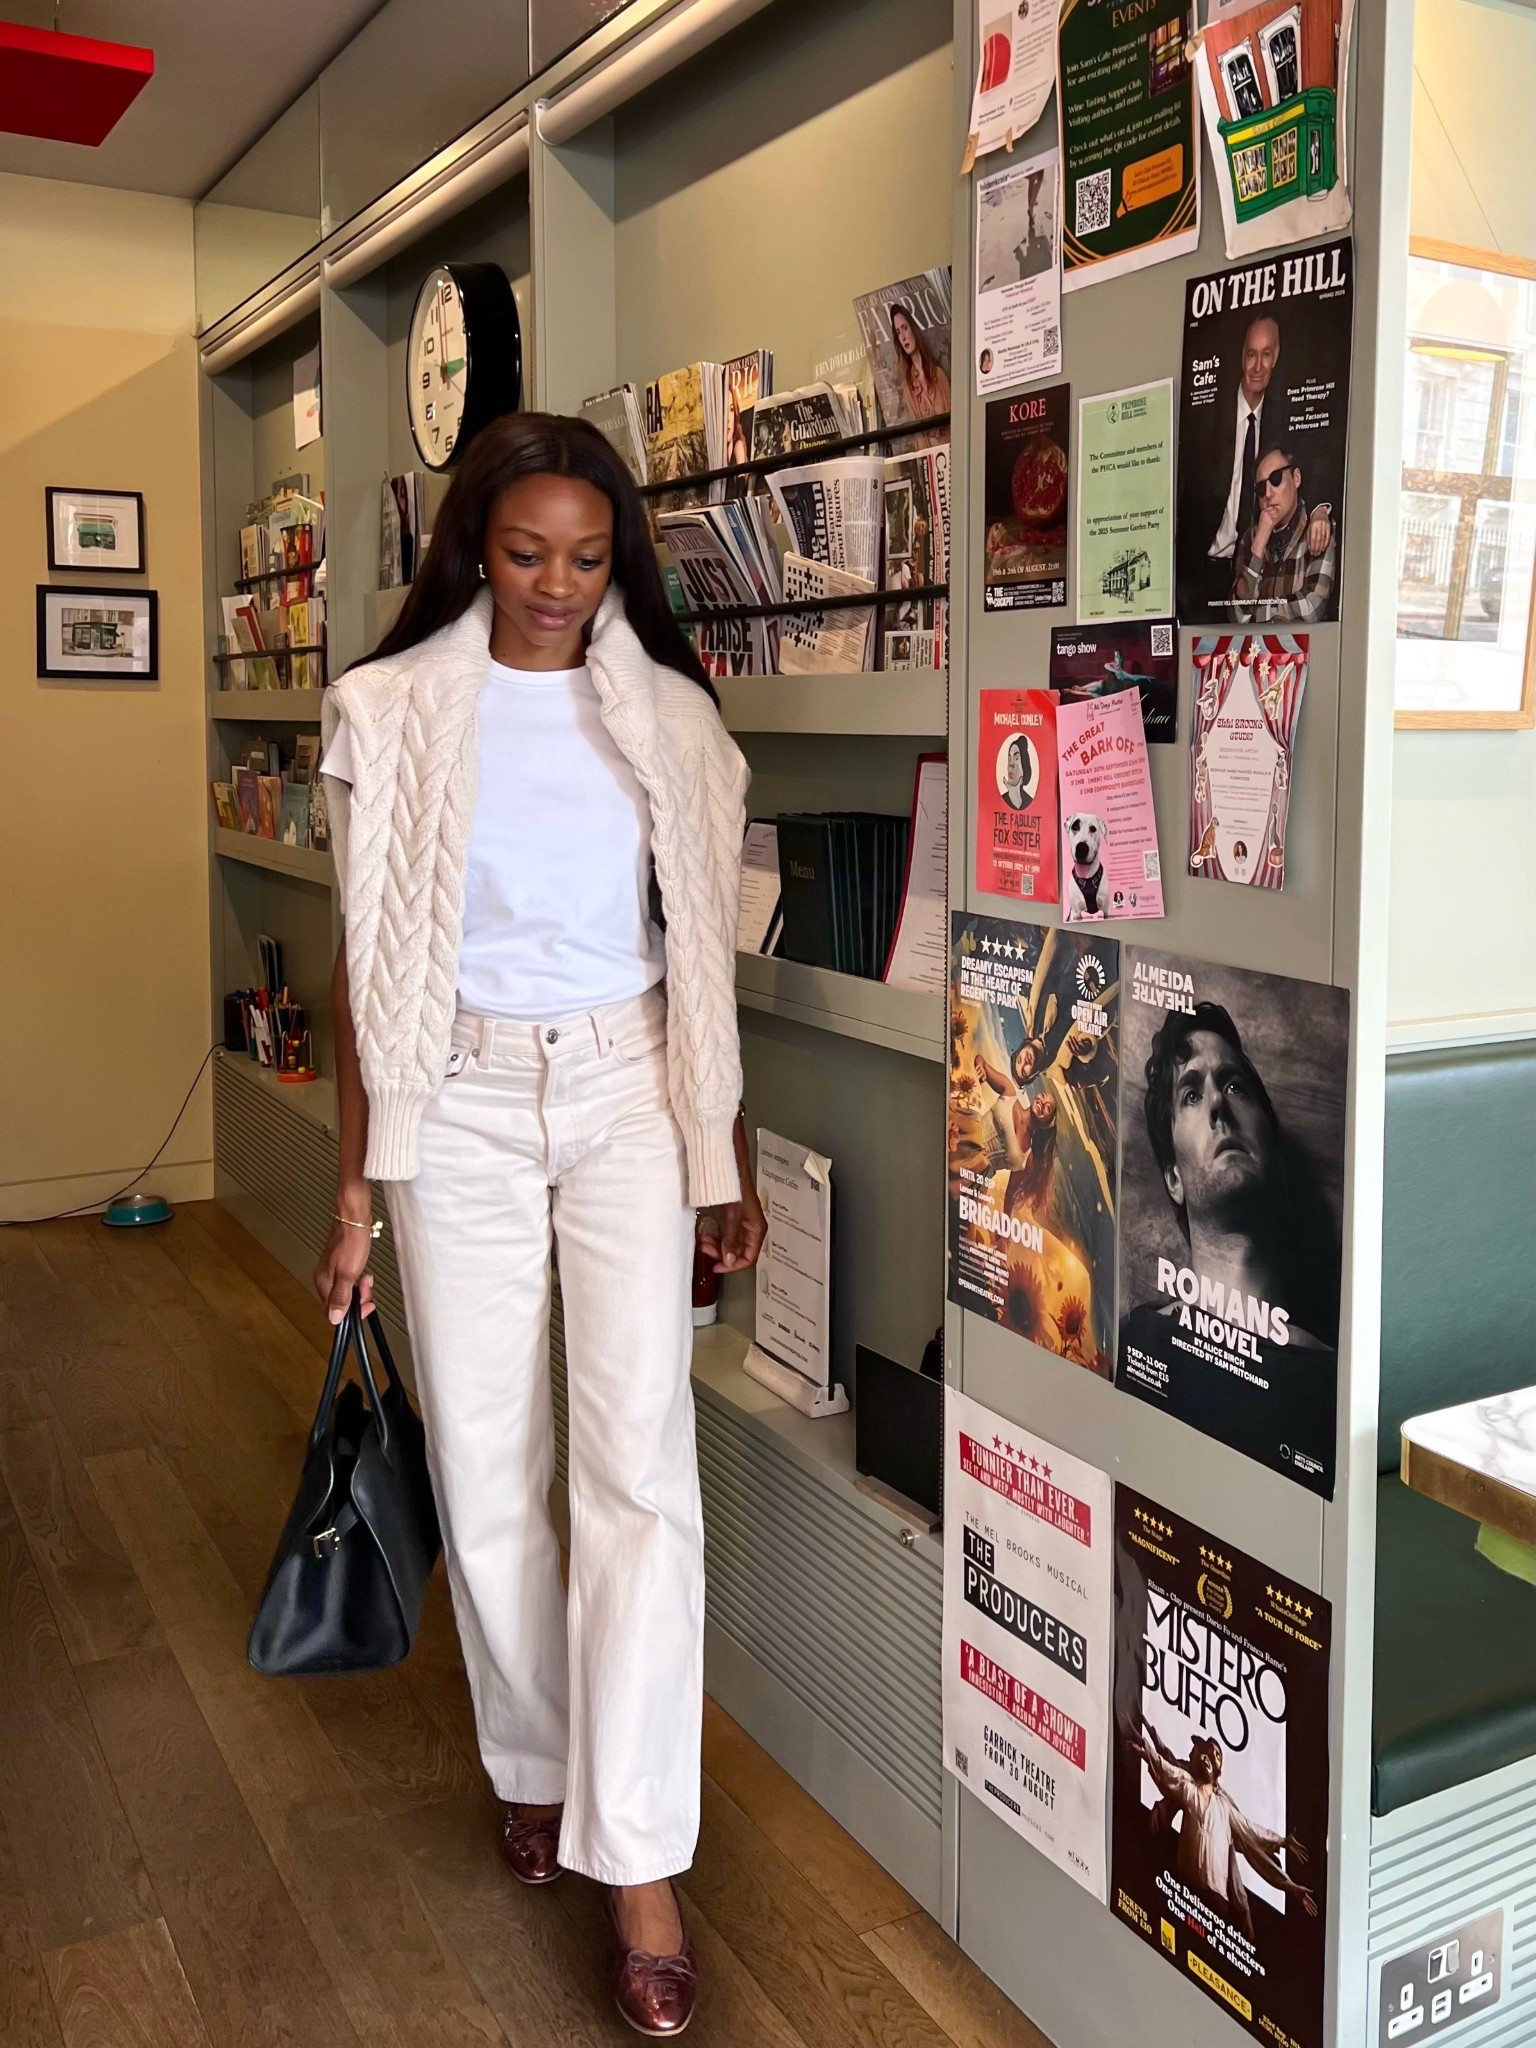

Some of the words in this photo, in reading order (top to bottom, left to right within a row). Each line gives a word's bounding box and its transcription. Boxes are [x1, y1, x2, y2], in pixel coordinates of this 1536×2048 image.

[1112, 0, 1157, 28] EVENTS
[442, 284, 453, 306] 12
[1192, 277, 1226, 319] ON
[1228, 263, 1277, 311] THE
[1281, 248, 1346, 298] HILL
[424, 337, 435, 357] 10
[1192, 355, 1220, 372] Sam's
[1193, 372, 1217, 387] Cafe:
[422, 372, 431, 390] 9
[795, 401, 814, 424] The
[1009, 398, 1047, 423] KORE
[431, 426, 441, 444] 7
[445, 435, 455, 453] 6
[791, 414, 840, 443] Guardian
[1089, 453, 1099, 462] The
[1099, 449, 1126, 460] Committee
[1126, 446, 1136, 455] and
[1136, 443, 1158, 453] members
[833, 478, 843, 528] figures
[1056, 644, 1078, 657] tango
[1077, 642, 1098, 653] show
[993, 713, 1020, 727] MICHAEL
[1020, 713, 1044, 727] CONLEY
[1061, 741, 1080, 763] THE
[1078, 721, 1106, 746] GREAT
[1080, 736, 1114, 767] BARK
[1116, 736, 1136, 756] OFF
[994, 811, 1009, 828] THE
[1010, 813, 1042, 832] FABULIST
[993, 828, 1010, 848] FOX
[1012, 831, 1041, 851] SISTER
[789, 860, 816, 880] Menu
[961, 956, 993, 976] DREAMY
[993, 962, 1034, 985] ESCAPISM
[961, 969, 969, 982] IN
[970, 971, 984, 987] THE
[984, 974, 1010, 993] HEART
[1010, 979, 1022, 995] OF
[1133, 961, 1195, 994] ALMEIDA
[960, 983, 996, 1004] REGENT'S
[996, 992, 1019, 1010] PARK
[1132, 981, 1197, 1016] THEATRE
[1071, 1004, 1093, 1024] OPEN
[1093, 1010, 1109, 1029] AIR
[1077, 1020, 1103, 1037] THEATRE
[959, 1167, 976, 1184] UNTIL
[976, 1173, 984, 1185] 20
[959, 1195, 1044, 1254] BRIGADOON
[1157, 1256, 1290, 1347] ROMANS
[1178, 1304, 1193, 1331] A
[1195, 1311, 1263, 1363] NOVEL
[1171, 1335, 1204, 1361] DIRECTED
[1204, 1352, 1213, 1365] BY
[1213, 1356, 1229, 1373] SAM
[1229, 1362, 1269, 1390] PRITCHARD
[1194, 1336, 1203, 1348] BY
[1203, 1340, 1223, 1357] ALICE
[1223, 1350, 1245, 1369] BIRCH
[1126, 1364, 1163, 1389] almeida.co.uk
[1012, 1487, 1035, 1510] MOSTLY
[1036, 1500, 1053, 1522] WITH
[1017, 1469, 1045, 1503] THAN
[1048, 1487, 1079, 1523] EVER.
[965, 1511, 979, 1531] THE
[984, 1524, 1000, 1544] MEL
[1006, 1538, 1041, 1569] BROOKS
[1047, 1563, 1088, 1600] MUSICAL
[968, 1530, 992, 1567] THE
[968, 1566, 1084, 1671] PRODUCERS
[1183, 1600, 1205, 1620] present
[1206, 1613, 1223, 1630] Dario
[1231, 1628, 1243, 1644] and
[1243, 1637, 1264, 1659] Franca
[1263, 1611, 1284, 1630] TOUR
[1284, 1623, 1295, 1636] DE
[1143, 1588, 1288, 1724] MISTERO
[979, 1652, 1010, 1693] BLAST
[1014, 1681, 1028, 1707] OF
[1031, 1694, 1038, 1715] A
[1043, 1702, 1081, 1749] SHOW!
[1143, 1640, 1250, 1752] BUFFO
[984, 1724, 1017, 1765] GARRICK
[1020, 1752, 1056, 1798] THEATRE
[984, 1743, 1005, 1770] FROM
[1009, 1763, 1019, 1782] 30
[1022, 1773, 1056, 1812] AUGUST
[1118, 1887, 1148, 1922] TICKETS
[1118, 1898, 1140, 1930] FROM
[1163, 1870, 1181, 1892] One
[1182, 1884, 1227, 1930] Deliveroo
[1227, 1924, 1257, 1955] driver
[1155, 1876, 1173, 1900] One
[1174, 1892, 1213, 1933] hundred
[1214, 1927, 1266, 1977] characters
[1167, 1898, 1186, 1923] One
[1187, 1915, 1206, 1938] Hell
[1207, 1934, 1217, 1951] of
[1218, 1946, 1225, 1961] a
[1226, 1954, 1252, 1978] show
[1193, 1957, 1246, 2013] PLEASANCE
